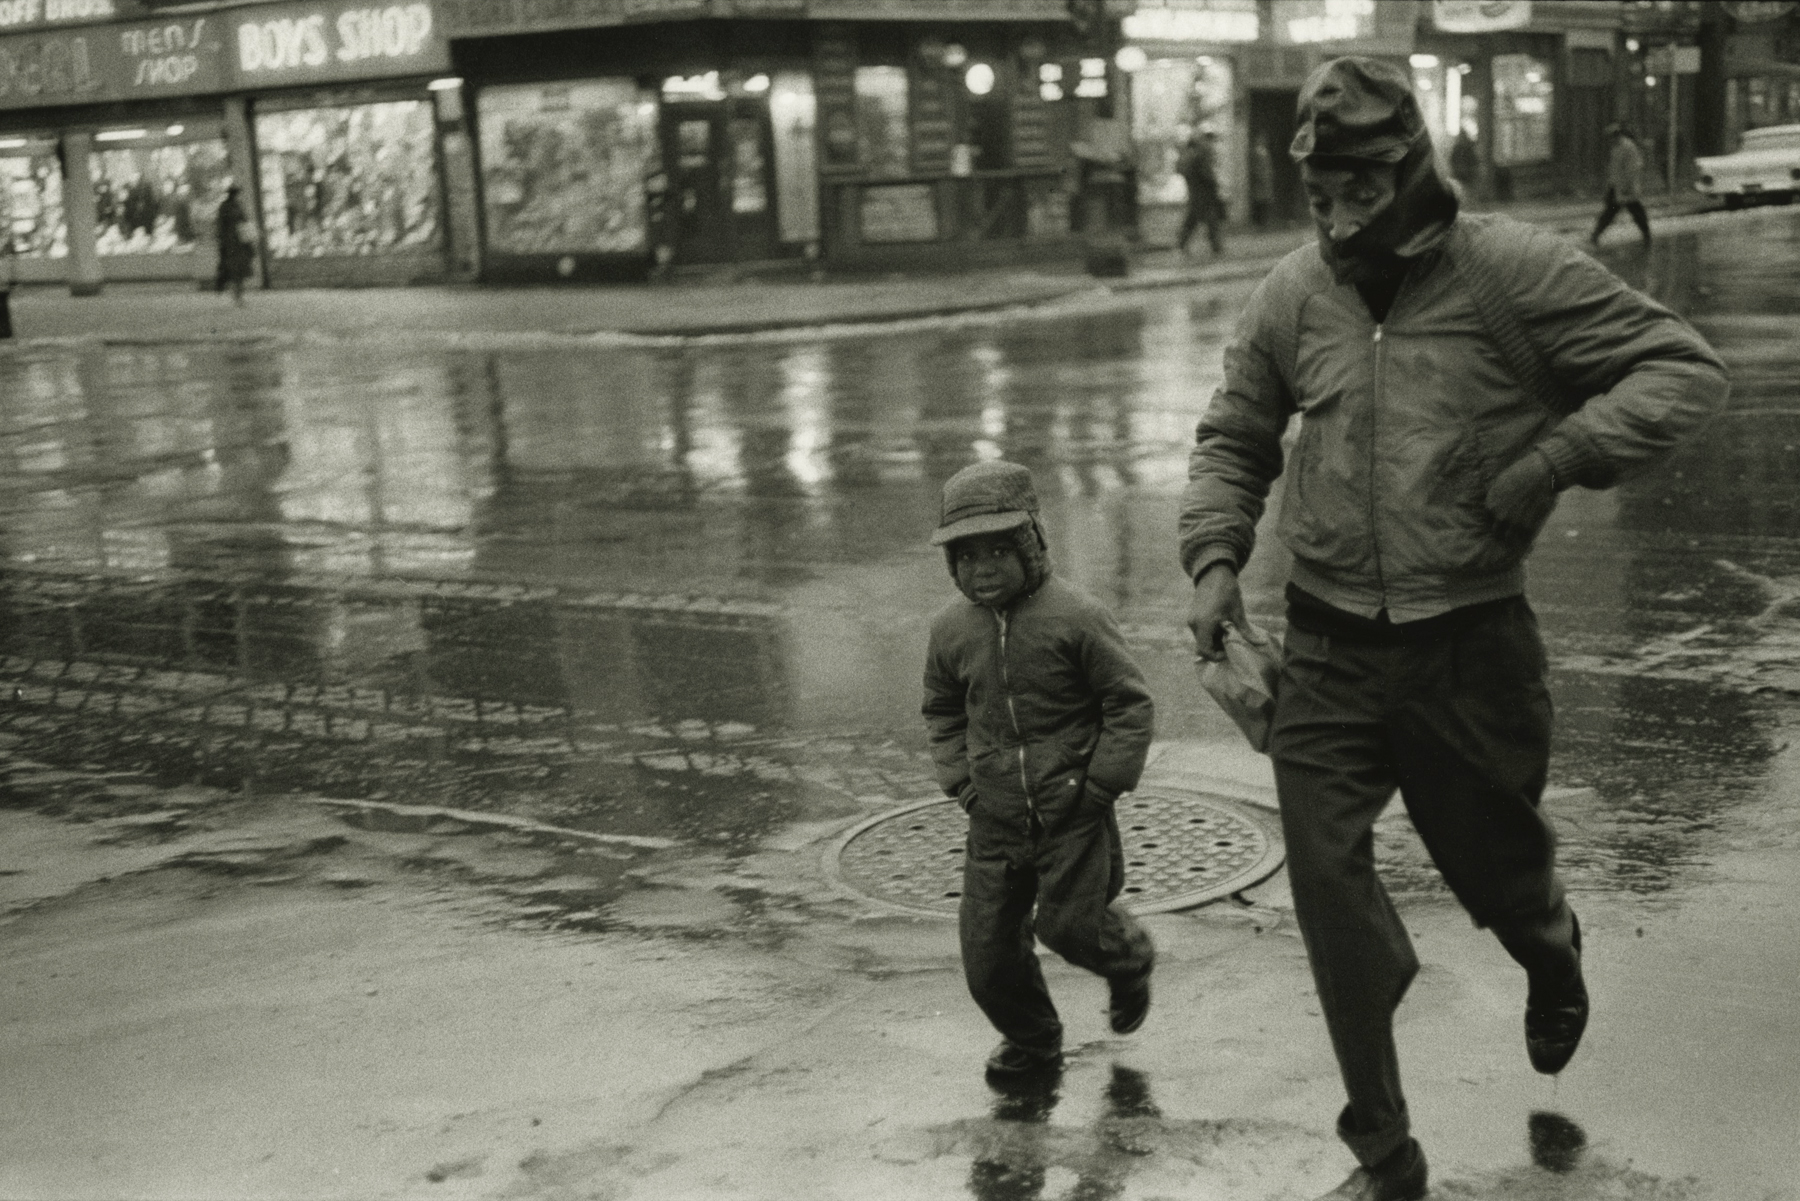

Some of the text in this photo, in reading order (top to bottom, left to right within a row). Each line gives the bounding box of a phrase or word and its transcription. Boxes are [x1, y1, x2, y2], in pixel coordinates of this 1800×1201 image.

[237, 3, 431, 71] BOYS SHOP
[132, 52, 199, 87] SHOP
